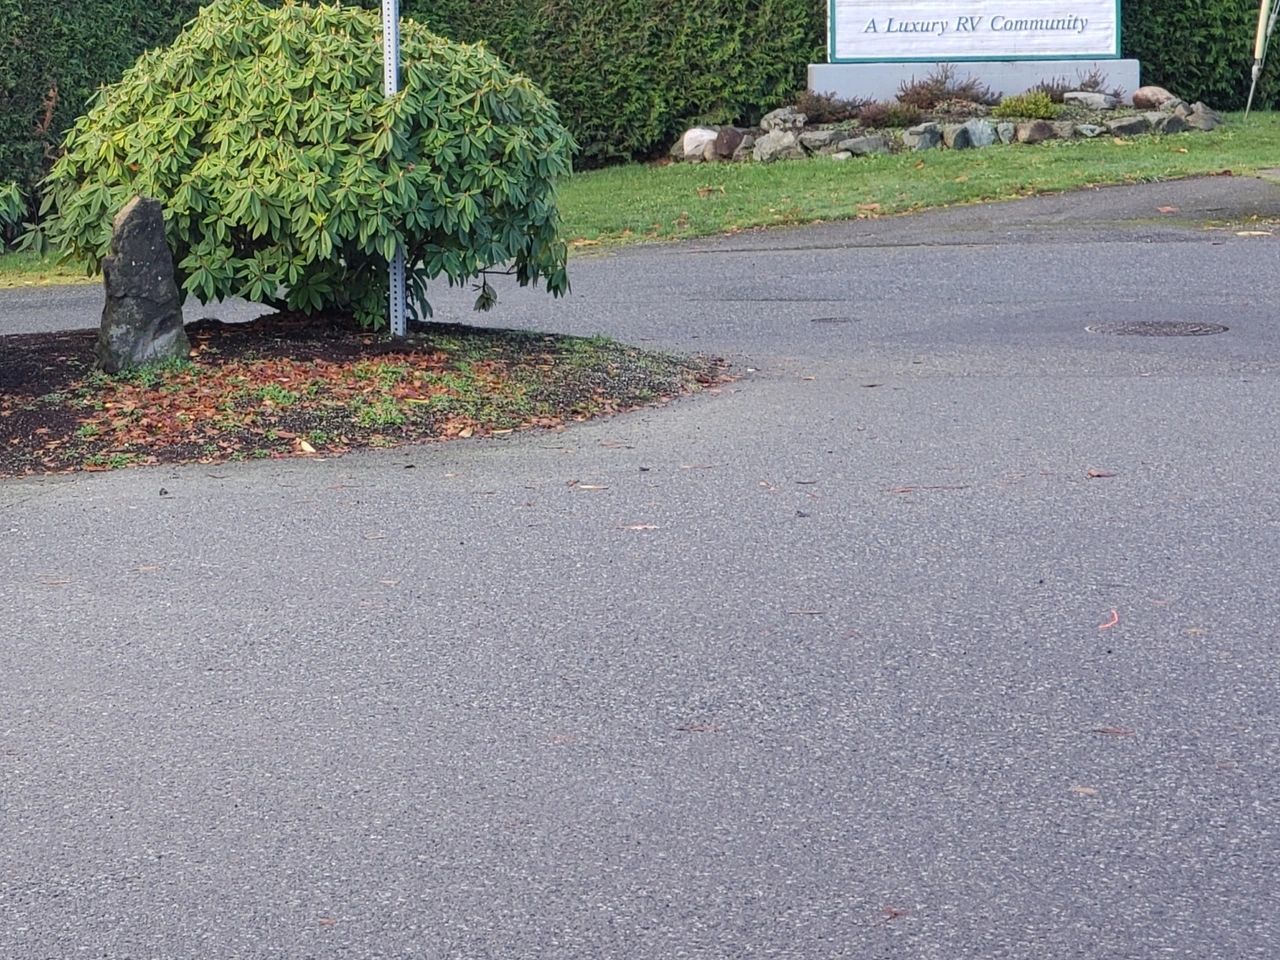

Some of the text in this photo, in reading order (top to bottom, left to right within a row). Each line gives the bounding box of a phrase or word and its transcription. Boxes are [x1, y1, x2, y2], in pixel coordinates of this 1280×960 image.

[863, 14, 1089, 36] A Luxury RV Community
